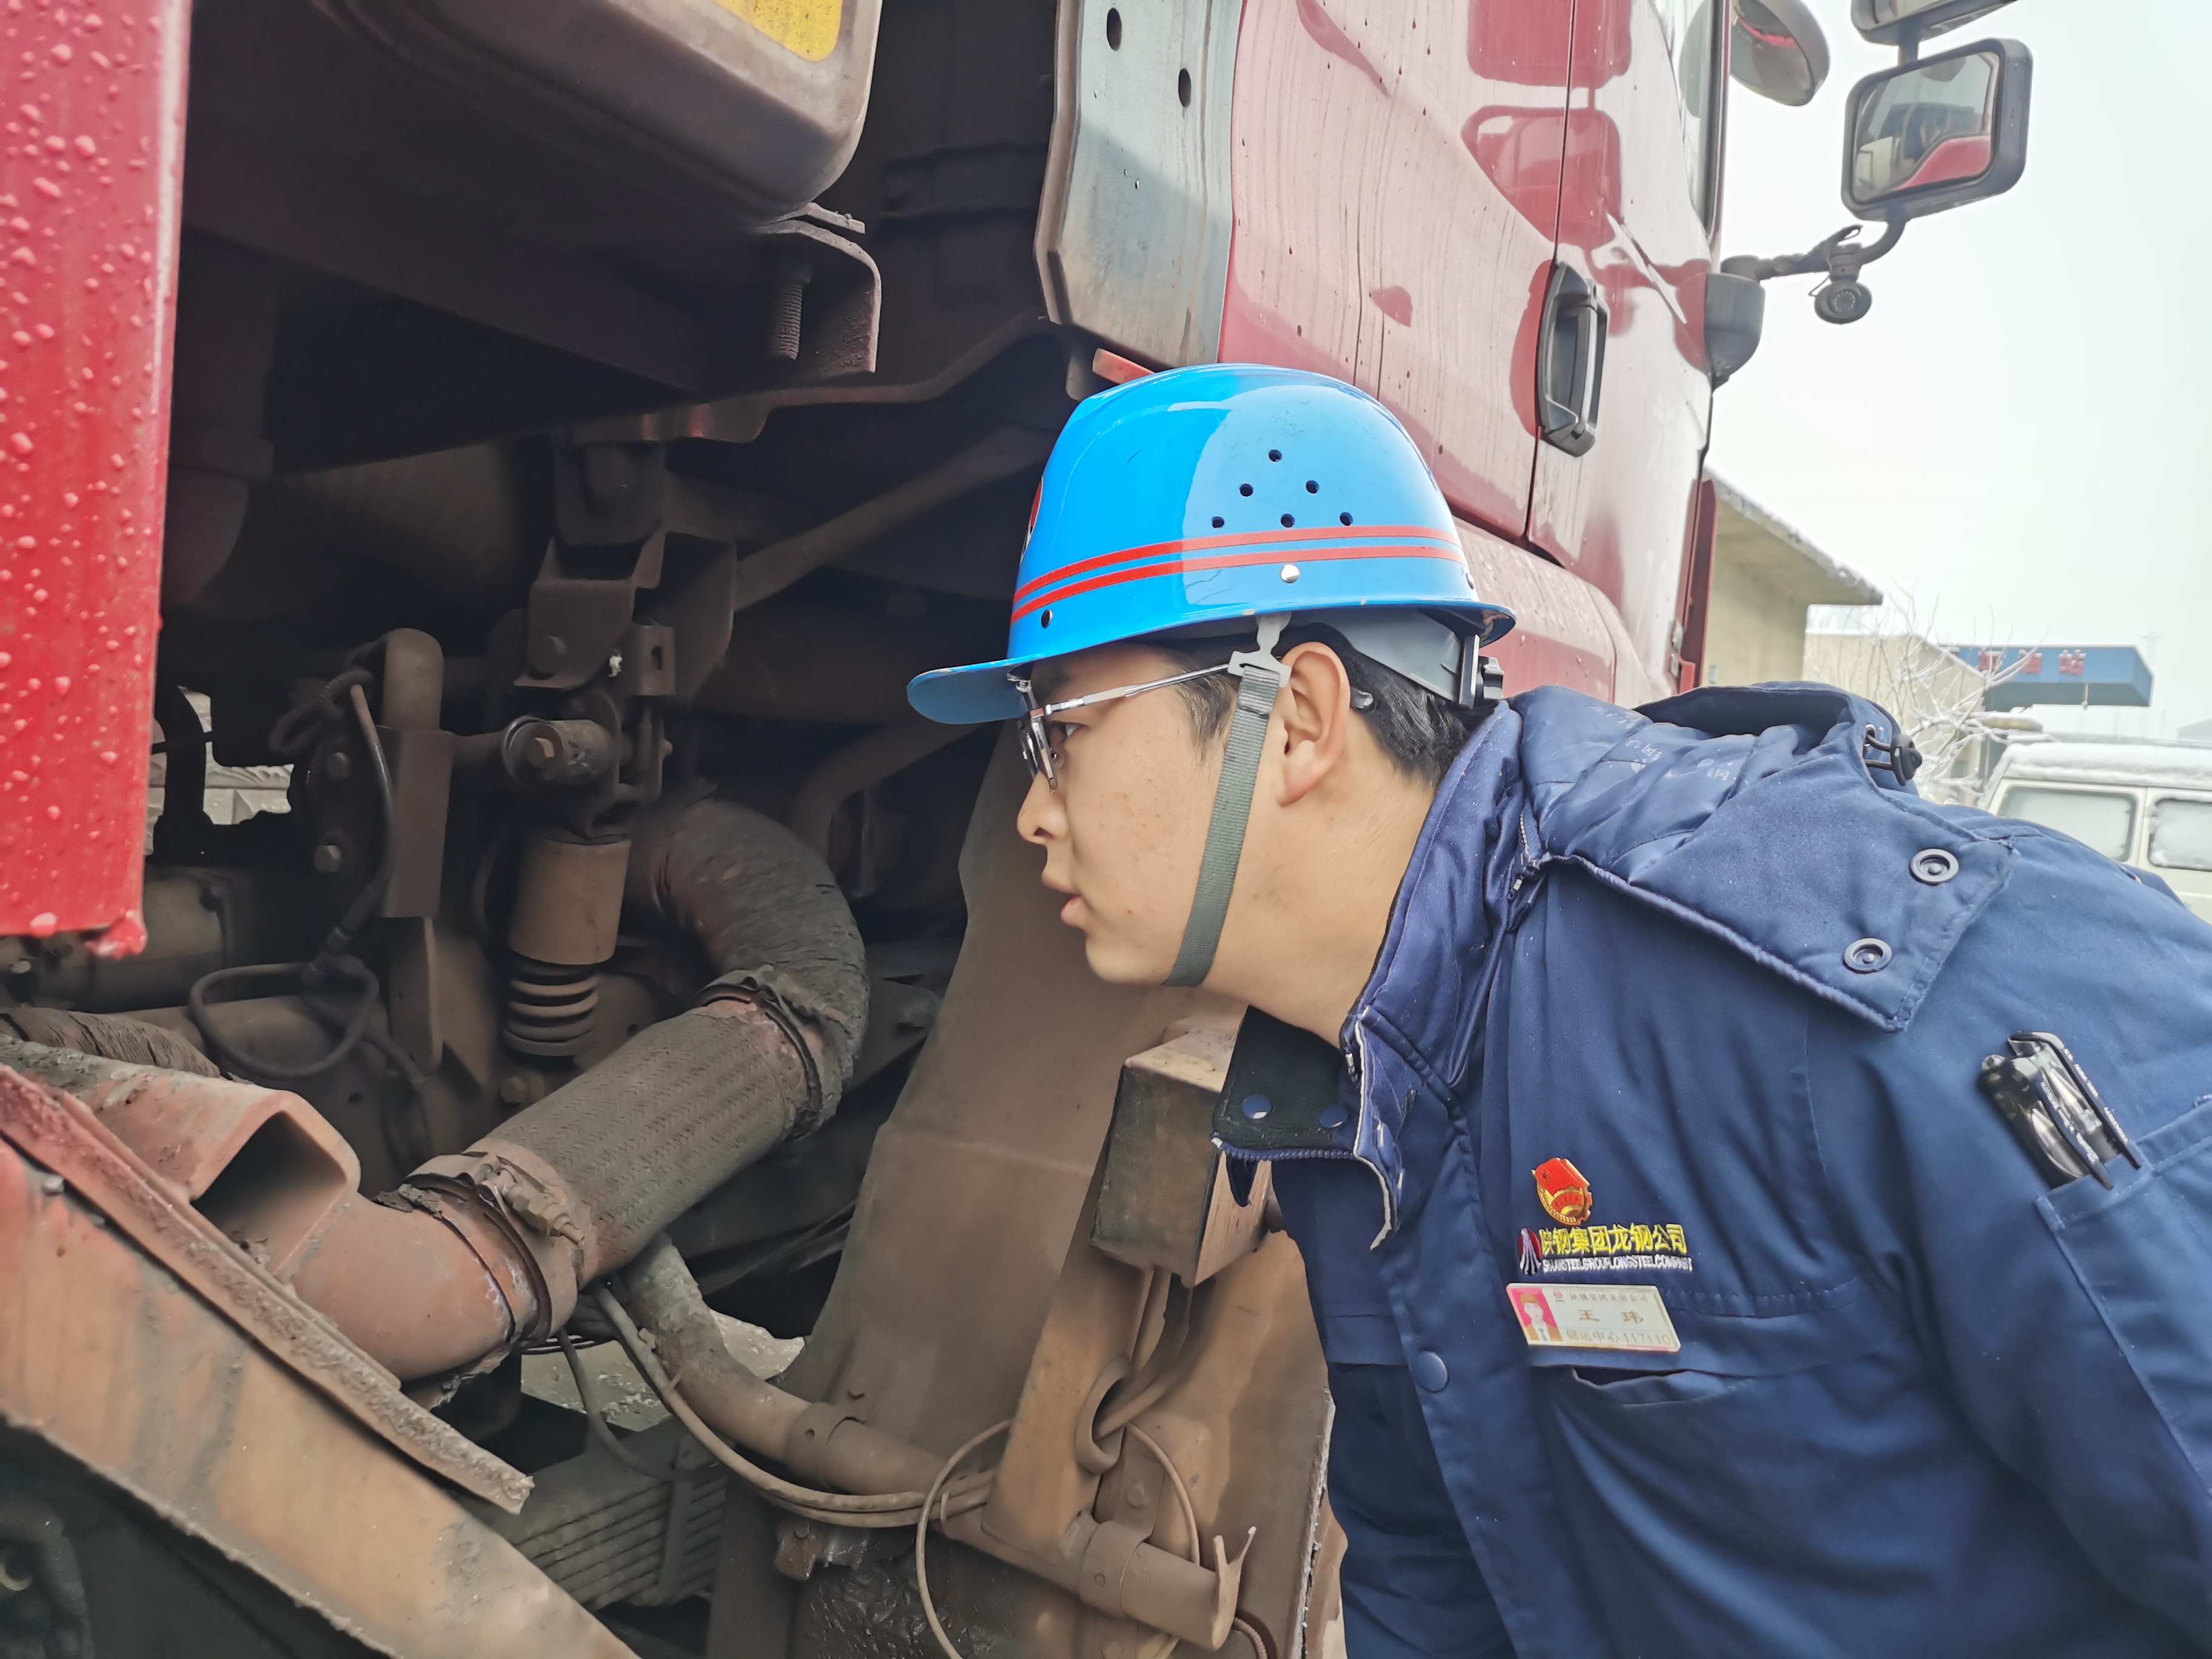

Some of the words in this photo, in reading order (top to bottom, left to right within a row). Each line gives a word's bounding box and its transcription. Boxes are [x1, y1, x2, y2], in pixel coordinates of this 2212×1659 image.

[1950, 647, 2086, 675] 加油站
[1539, 1222, 1687, 1255] 陕钢集团龙钢公司
